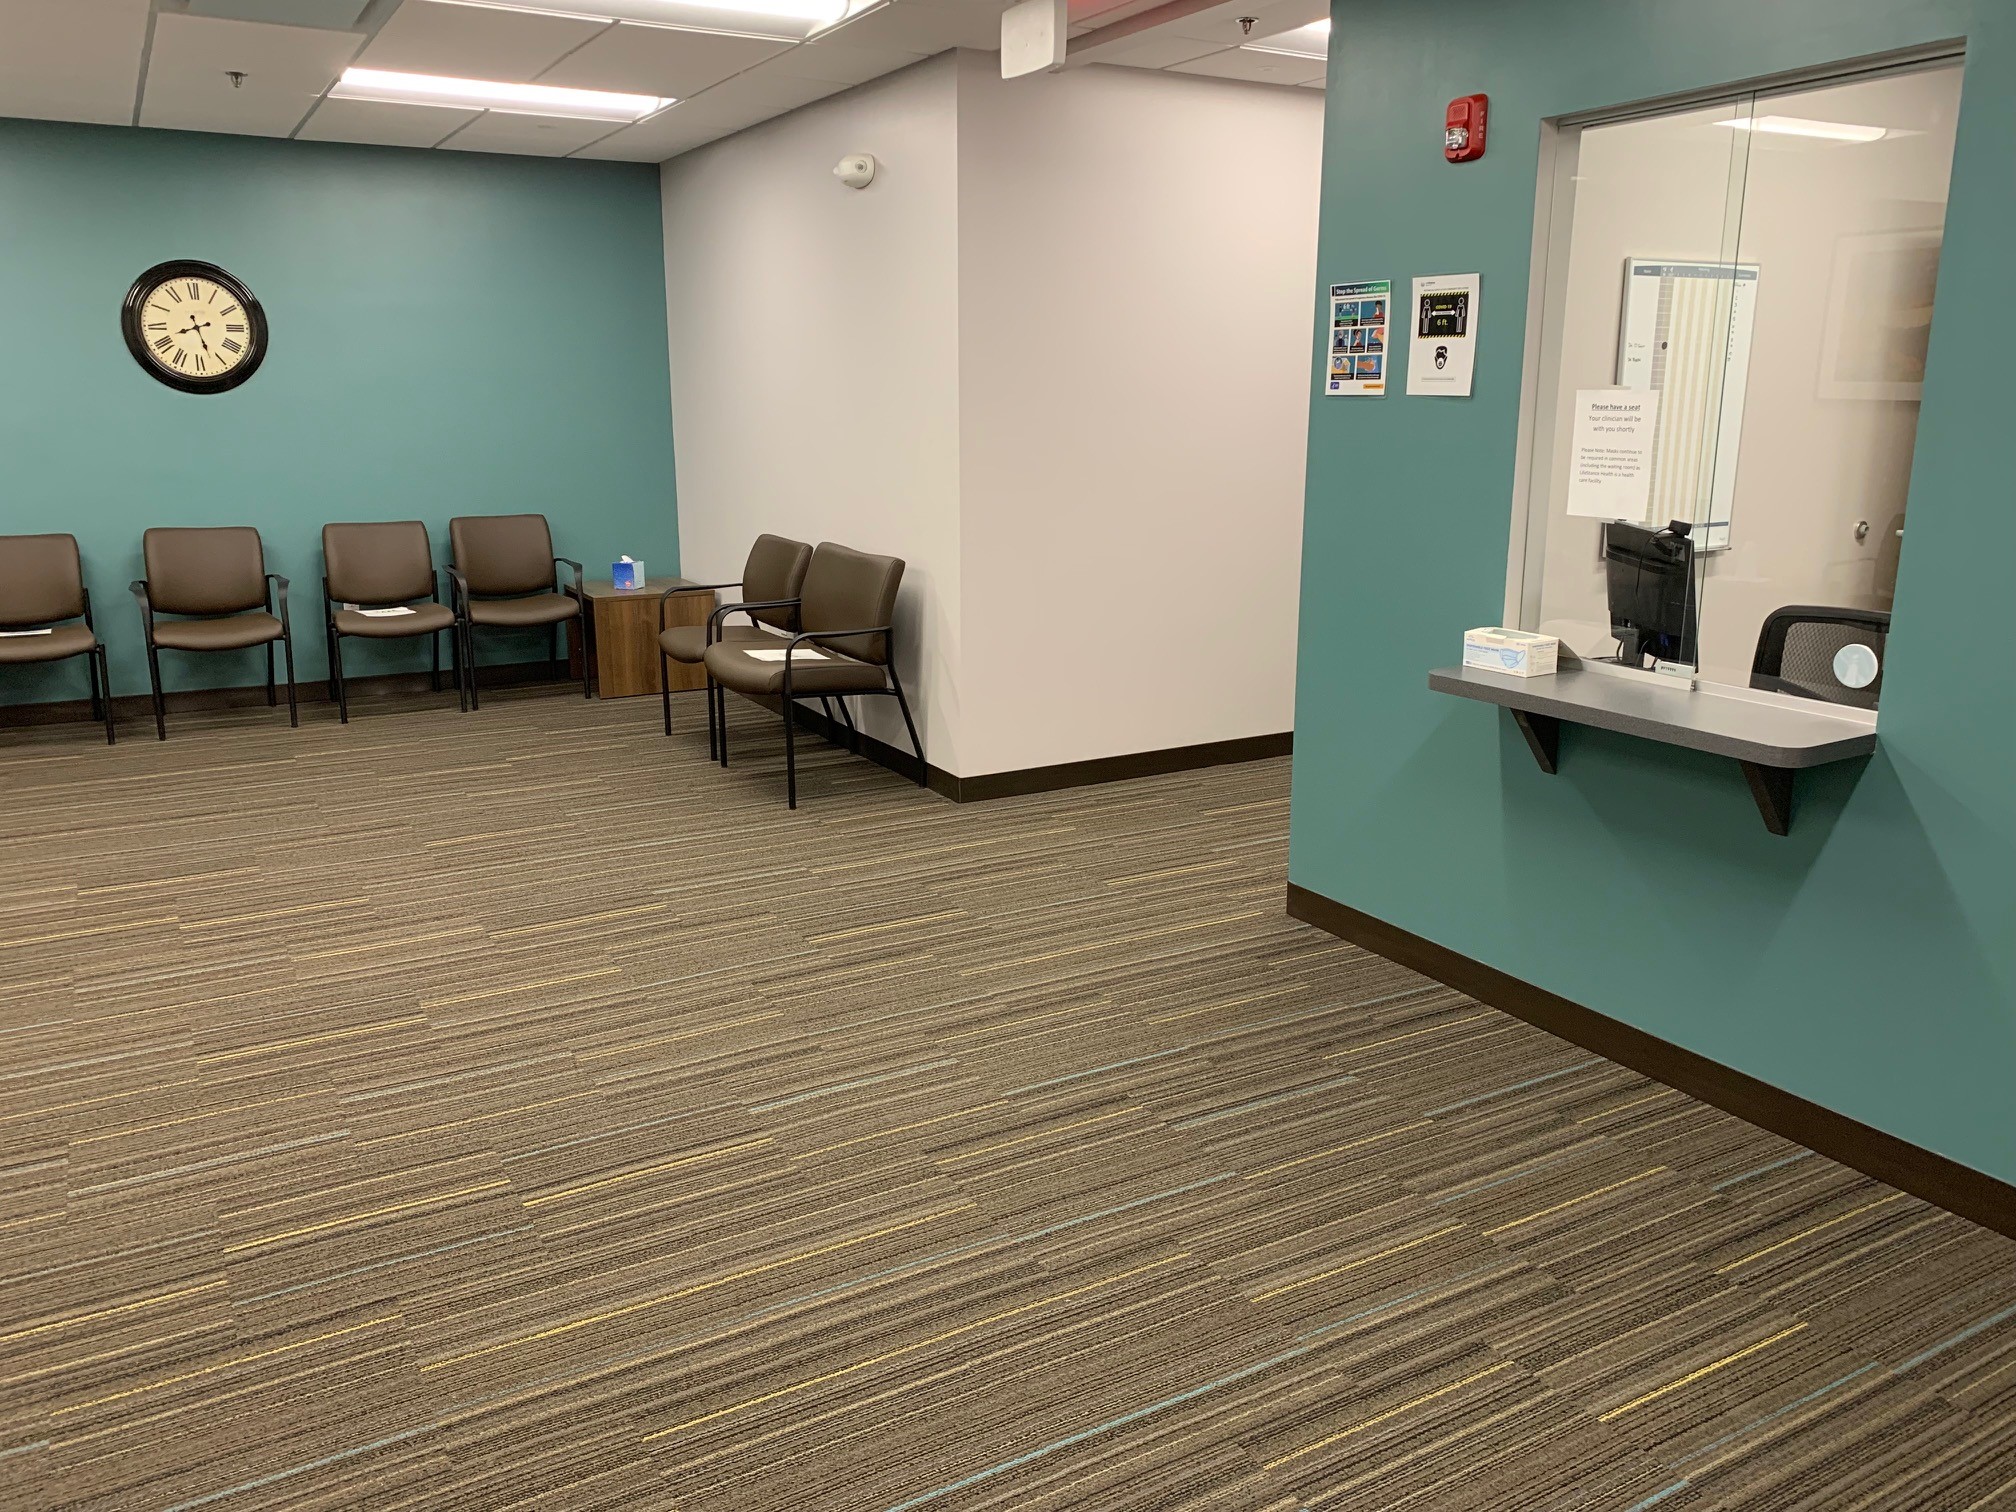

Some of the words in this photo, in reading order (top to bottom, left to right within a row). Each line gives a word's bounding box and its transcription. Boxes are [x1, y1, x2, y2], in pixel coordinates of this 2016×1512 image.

[1353, 286, 1368, 294] Spread
[1437, 318, 1442, 326] 6
[1591, 403, 1609, 411] Please
[1610, 403, 1623, 411] have
[1616, 426, 1635, 434] shortly
